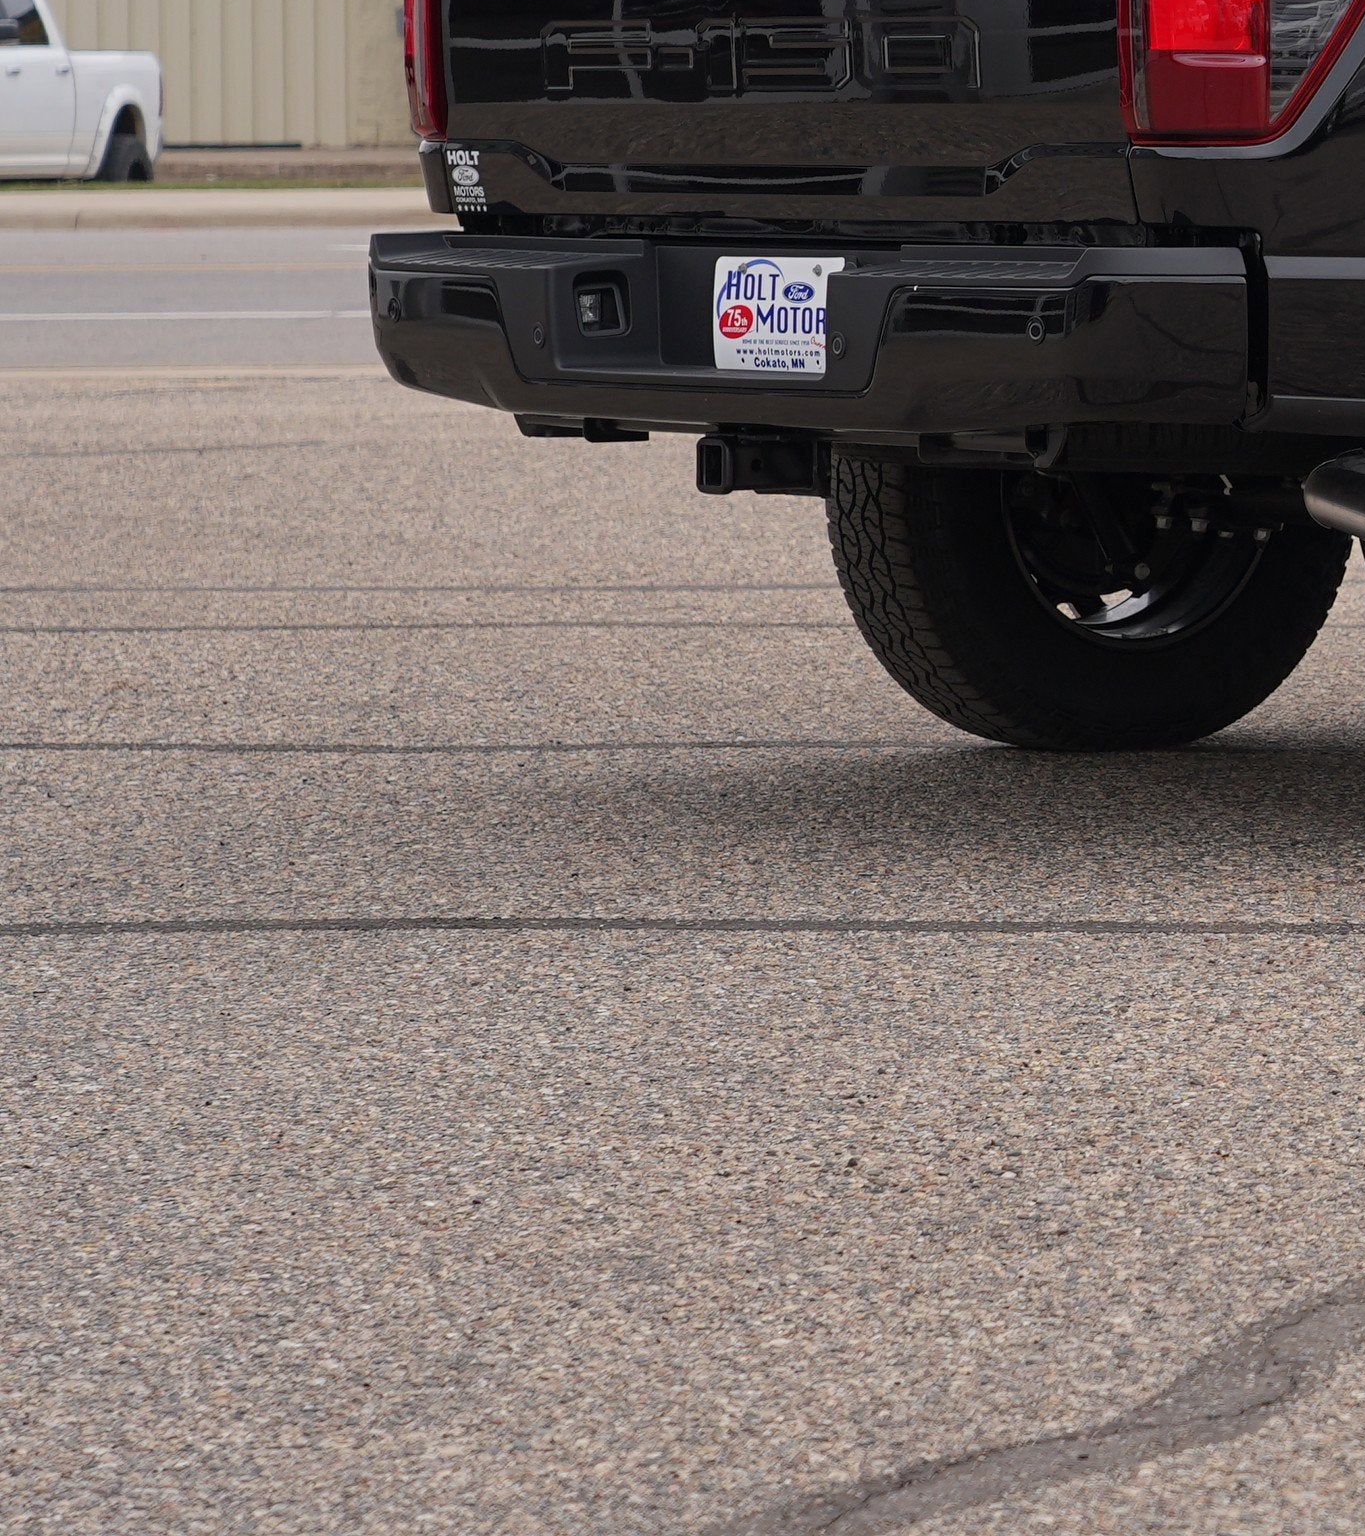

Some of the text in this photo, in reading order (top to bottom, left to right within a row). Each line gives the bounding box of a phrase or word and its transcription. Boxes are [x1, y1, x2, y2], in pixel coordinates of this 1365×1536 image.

[541, 17, 981, 92] F-150
[446, 150, 479, 165] HOLT
[453, 186, 484, 196] MOTORS
[726, 271, 780, 300] HOLT
[787, 284, 809, 301] Ford
[726, 309, 748, 327] 75th
[756, 304, 826, 334] MOTOR
[735, 348, 821, 357] www.holtmotors.com
[754, 357, 806, 370] Cokato, MN
